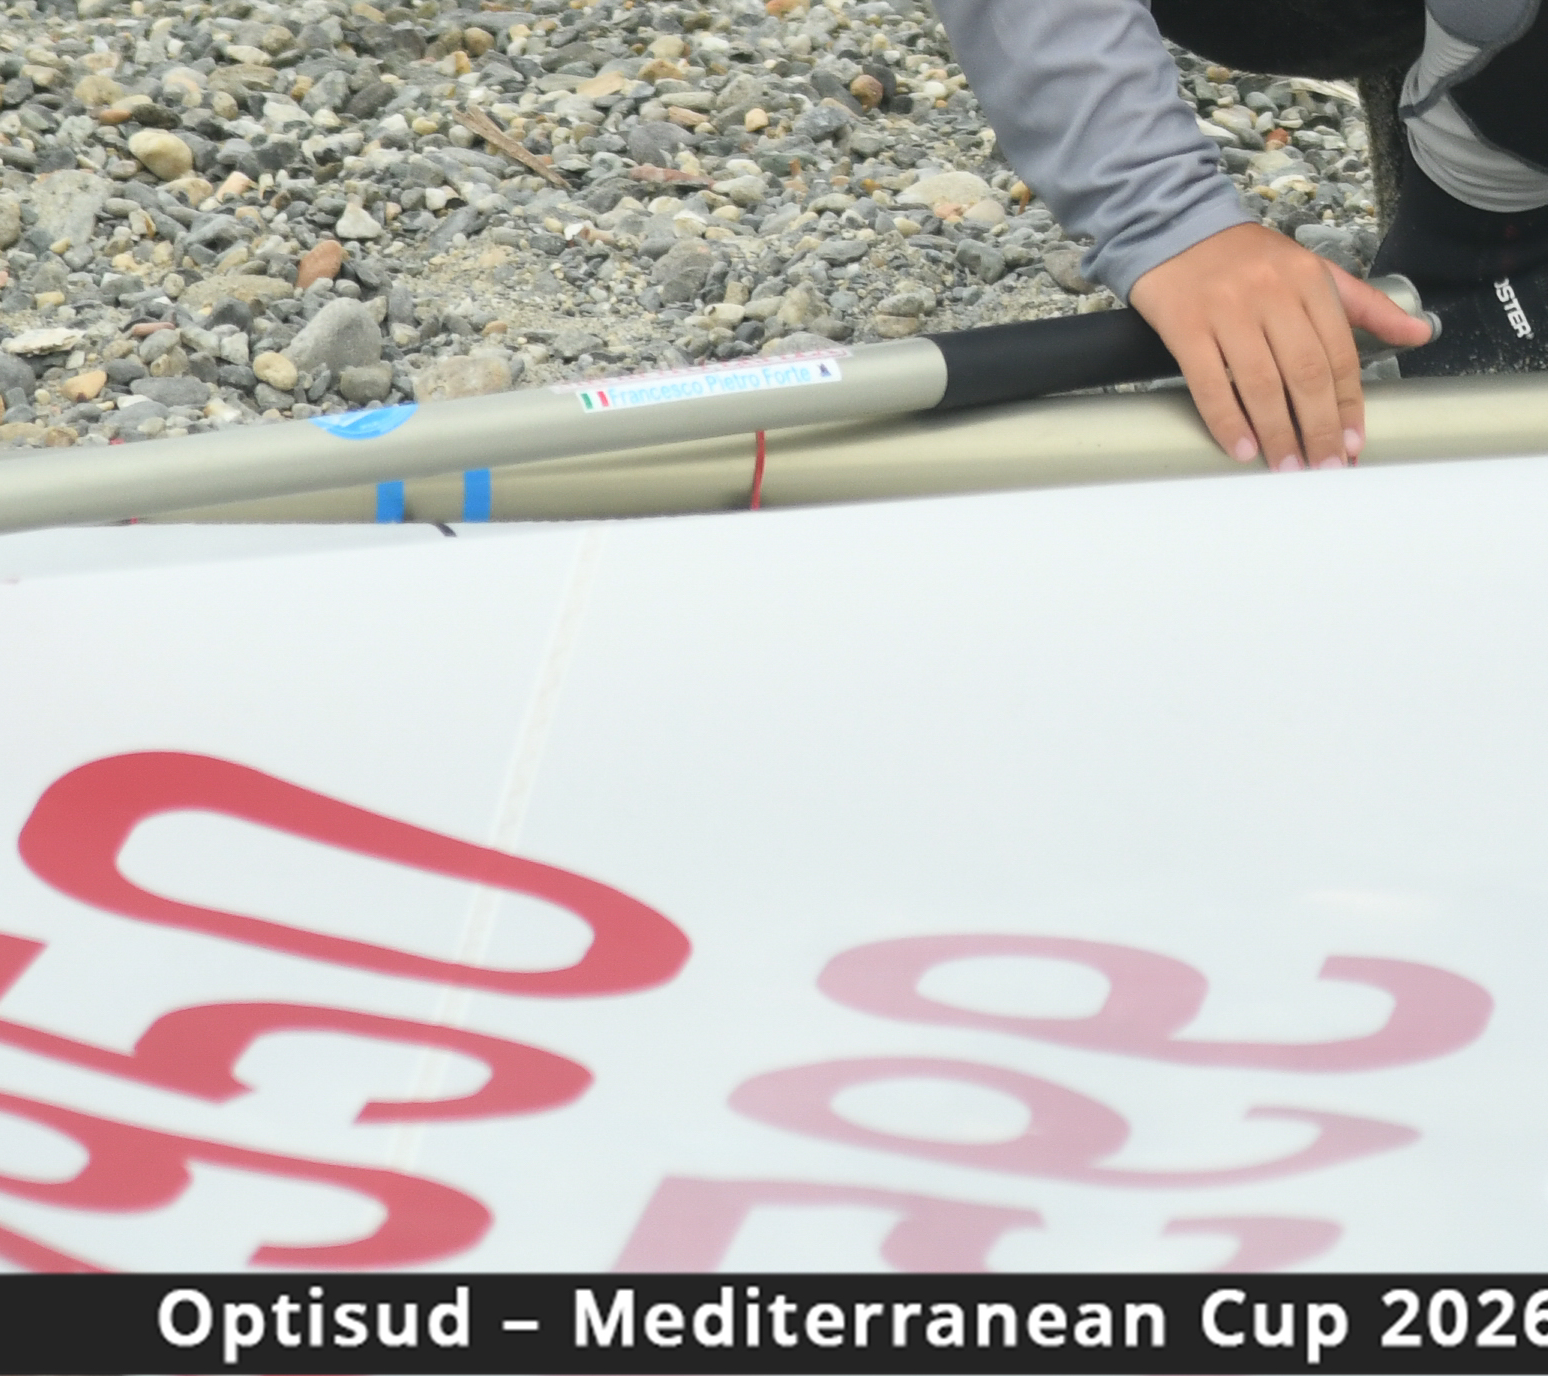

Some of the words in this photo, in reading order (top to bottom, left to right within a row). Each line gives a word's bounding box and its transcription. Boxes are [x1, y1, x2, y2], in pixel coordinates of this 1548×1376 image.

[1493, 277, 1533, 339] STER
[609, 377, 704, 406] Francesco
[704, 370, 761, 394] Pietro
[763, 363, 811, 385] Forte
